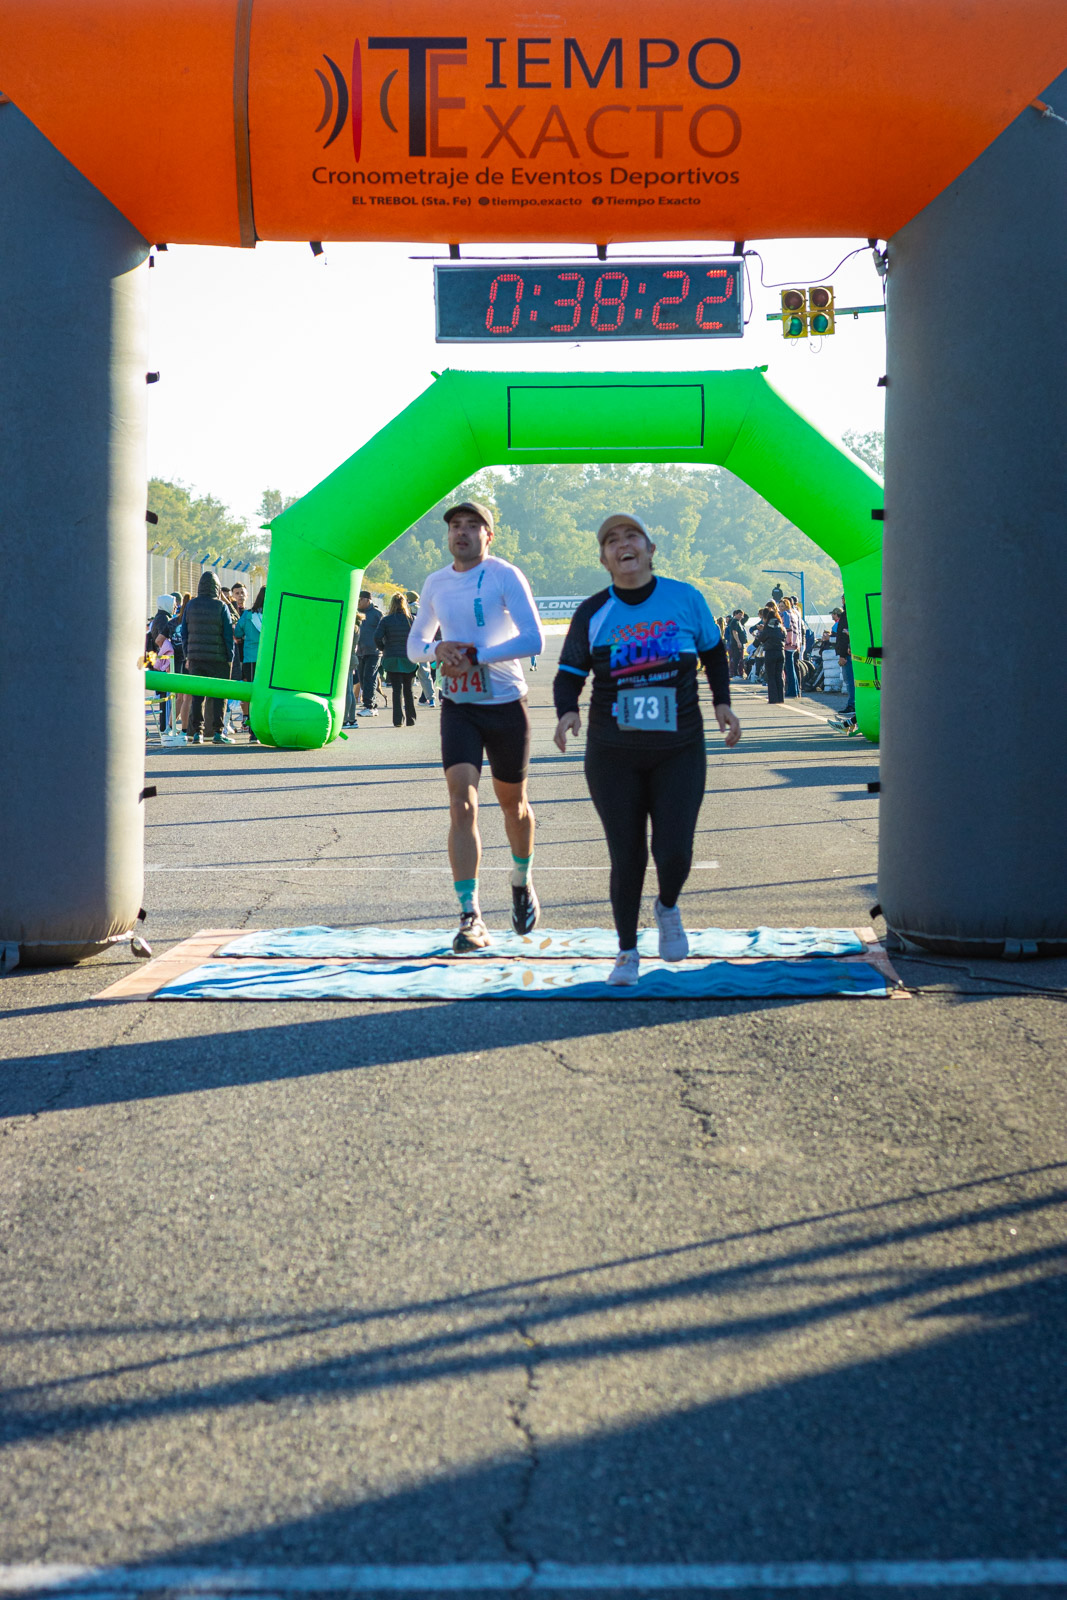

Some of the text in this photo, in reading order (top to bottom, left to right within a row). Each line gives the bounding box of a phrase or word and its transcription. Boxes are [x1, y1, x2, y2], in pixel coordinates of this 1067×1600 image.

[312, 166, 740, 189] Cronometraje de Eventos Deportivos
[352, 196, 472, 207] EL TREBOL (Sta. Fe)
[491, 196, 583, 208] tiempo.exacto
[605, 196, 702, 207] Tiempo Exacto
[485, 269, 734, 334] 0:38:22
[633, 696, 660, 720] 73
